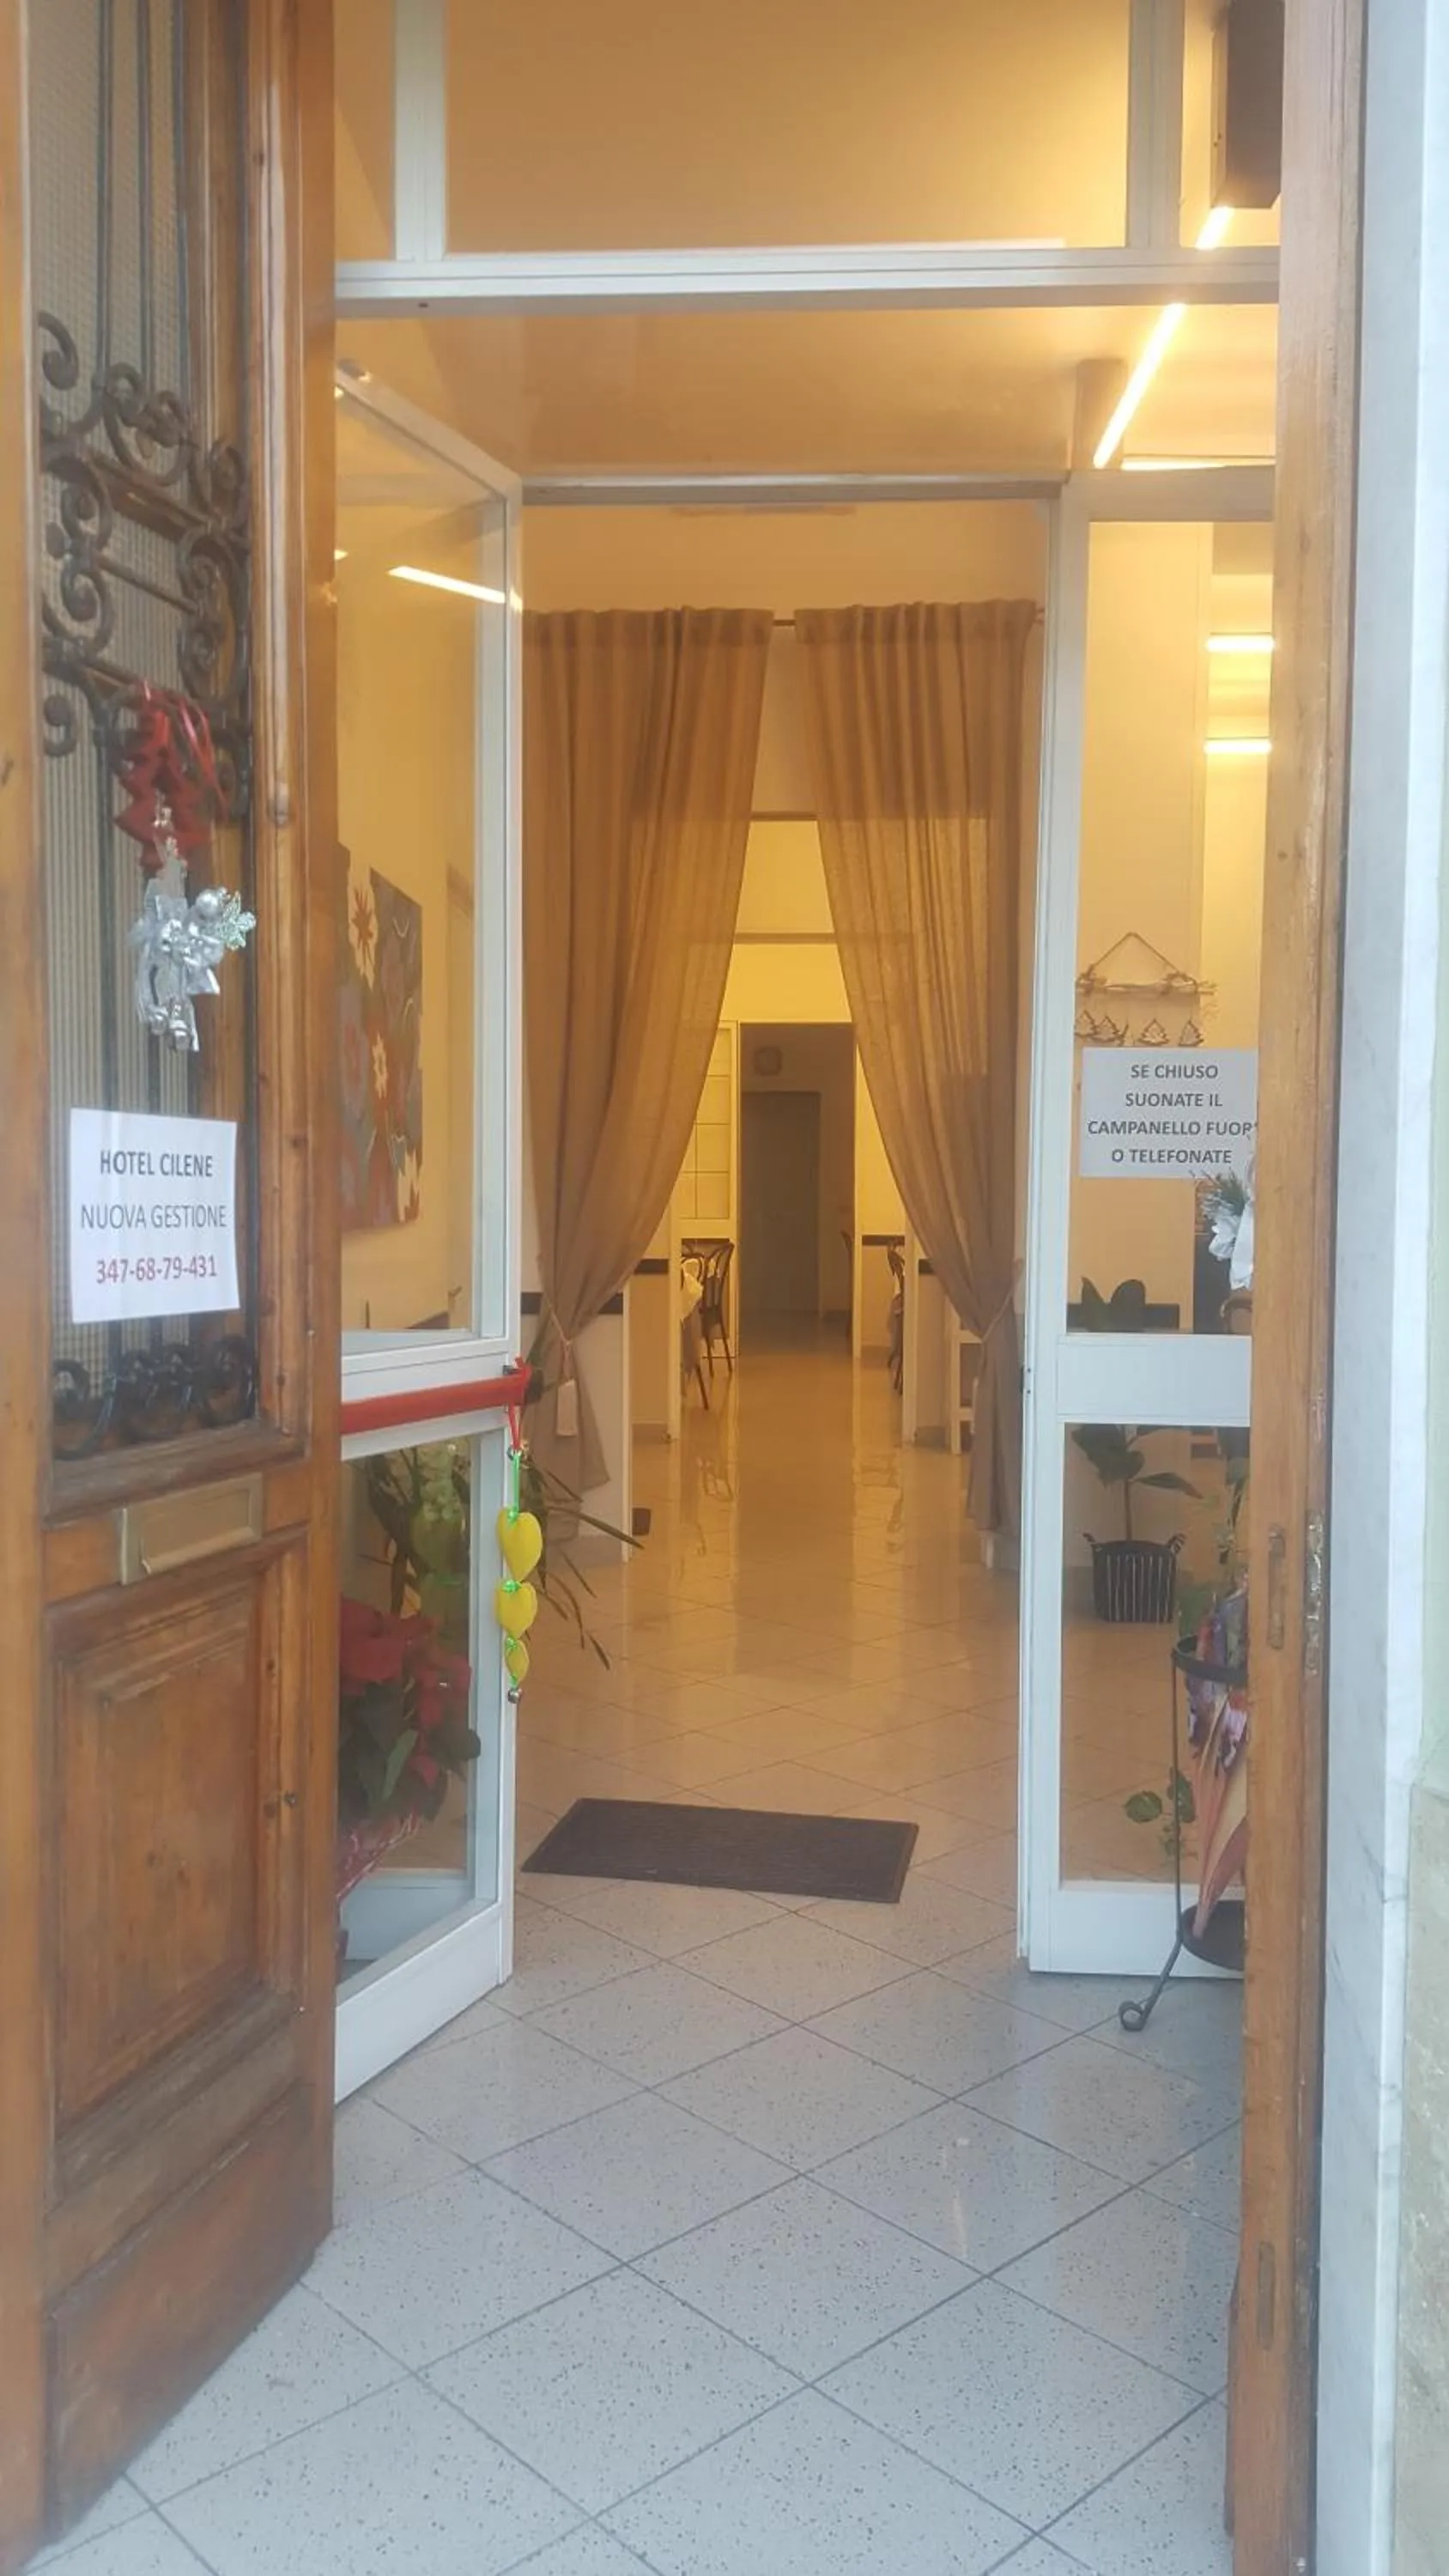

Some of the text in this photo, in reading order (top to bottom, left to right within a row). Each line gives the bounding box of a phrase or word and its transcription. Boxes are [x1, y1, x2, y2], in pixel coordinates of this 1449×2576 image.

[1131, 1064, 1219, 1079] SE CHIUSO
[1125, 1092, 1223, 1107] SUONATE IL
[1088, 1121, 1201, 1136] CAMPANELLO
[100, 1150, 214, 1177] HOTEL CILENE
[1112, 1149, 1233, 1163] O TELEFONATE
[81, 1204, 227, 1230] NUOVA GESTIONE
[96, 1255, 217, 1285] 347-68-79-431
